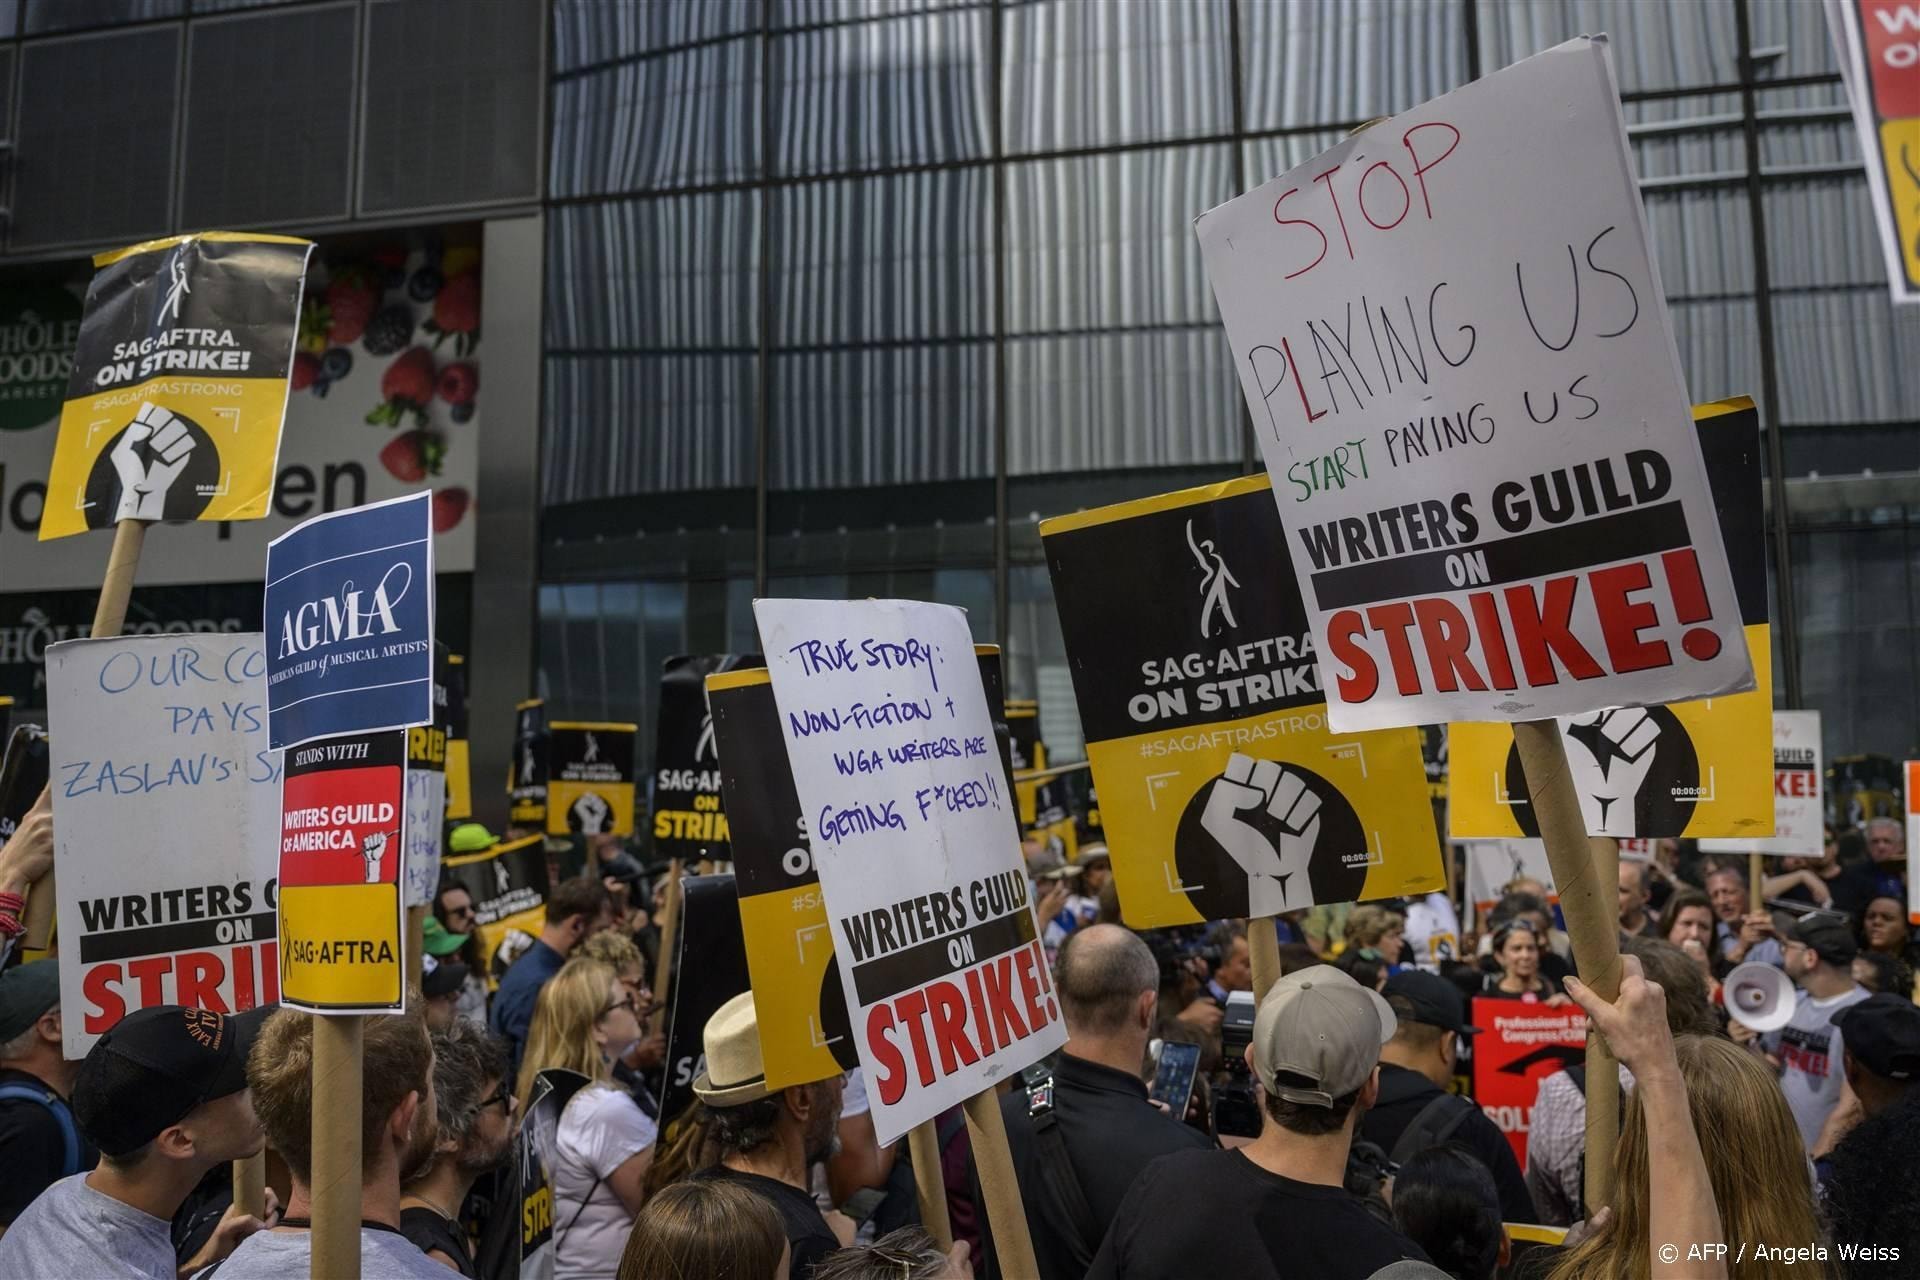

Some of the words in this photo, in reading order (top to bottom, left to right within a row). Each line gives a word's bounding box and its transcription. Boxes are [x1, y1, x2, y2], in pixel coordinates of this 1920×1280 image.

[1275, 122, 1461, 279] STOP
[1249, 282, 1476, 442] PLAYING
[1516, 226, 1639, 351] US
[96, 361, 135, 386] ON
[139, 349, 251, 377] STRIKE!
[94, 383, 243, 410] #SAGAFTRASTRONG
[1287, 437, 1370, 502] START
[1384, 402, 1495, 468] PAYING
[1524, 375, 1599, 424] US
[1298, 491, 1479, 570] WRITERS
[1491, 448, 1672, 534] GUILD
[1445, 549, 1490, 588] ON
[278, 563, 412, 660] AGMA
[1326, 546, 1722, 704] STRIKE!
[100, 647, 218, 693] OUR
[295, 659, 318, 675] GUILD
[330, 649, 379, 666] MUSICAL
[381, 640, 428, 658] ARTISTS
[790, 638, 857, 676] TRUE
[862, 637, 944, 692] STORY:
[164, 702, 262, 734] PAYS
[789, 692, 931, 738] NON-FICTION
[1128, 687, 1188, 722] ON
[295, 746, 325, 767] STANDS
[327, 742, 370, 761] WITH
[834, 749, 885, 776] WGA
[889, 739, 961, 763] WRITERS
[964, 736, 987, 760] ARE
[284, 806, 330, 830] WRITERS
[331, 803, 394, 826] GUILD
[694, 795, 719, 811] ON
[819, 799, 906, 844] GETTING
[292, 829, 356, 852] AMERICA
[79, 881, 252, 932] WRITERS
[841, 886, 968, 963] WRITERS
[969, 869, 1027, 926] GUILD
[216, 918, 253, 943] ON
[947, 933, 976, 968] ON
[866, 939, 1058, 1106] STRIKE!
